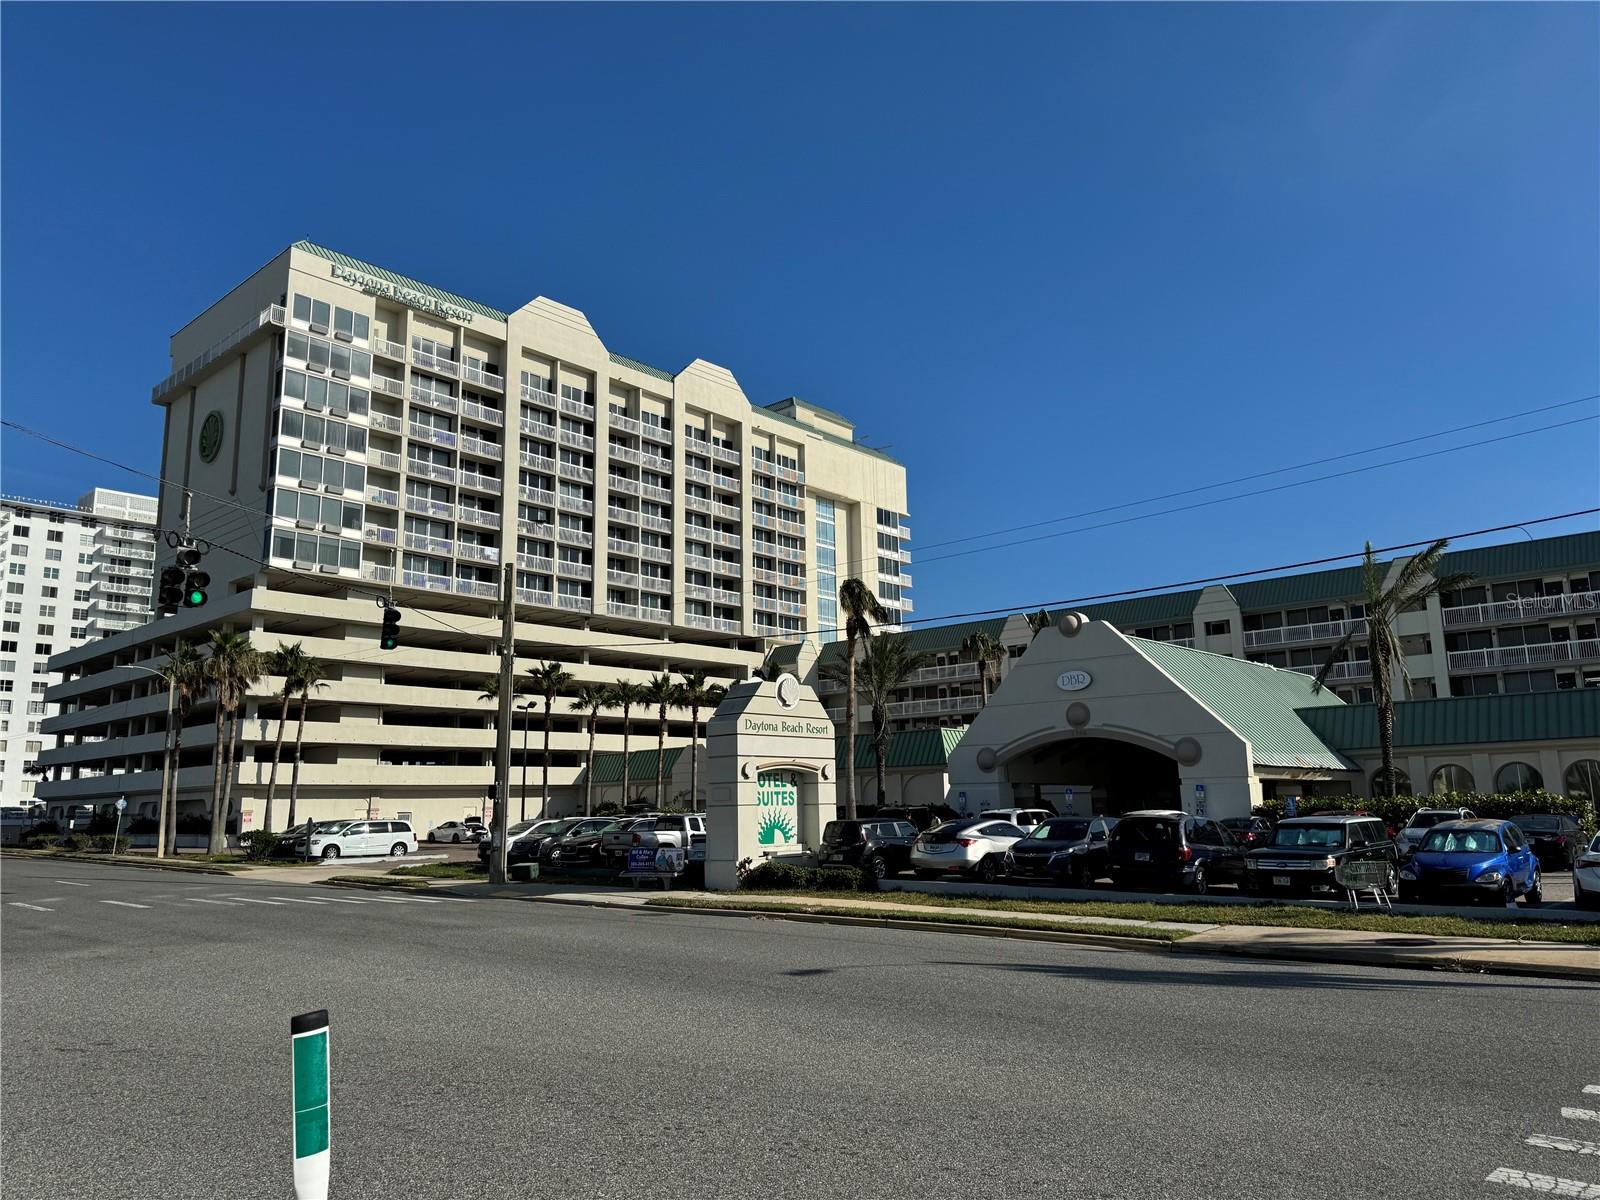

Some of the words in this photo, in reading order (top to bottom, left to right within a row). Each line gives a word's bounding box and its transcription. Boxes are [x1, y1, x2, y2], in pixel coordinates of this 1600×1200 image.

[1061, 673, 1086, 686] DBR
[744, 718, 778, 733] Daytona
[781, 721, 804, 733] Beach
[806, 722, 828, 734] Resort
[757, 772, 787, 788] OTEL
[790, 772, 798, 788] &
[757, 790, 795, 806] SUITES
